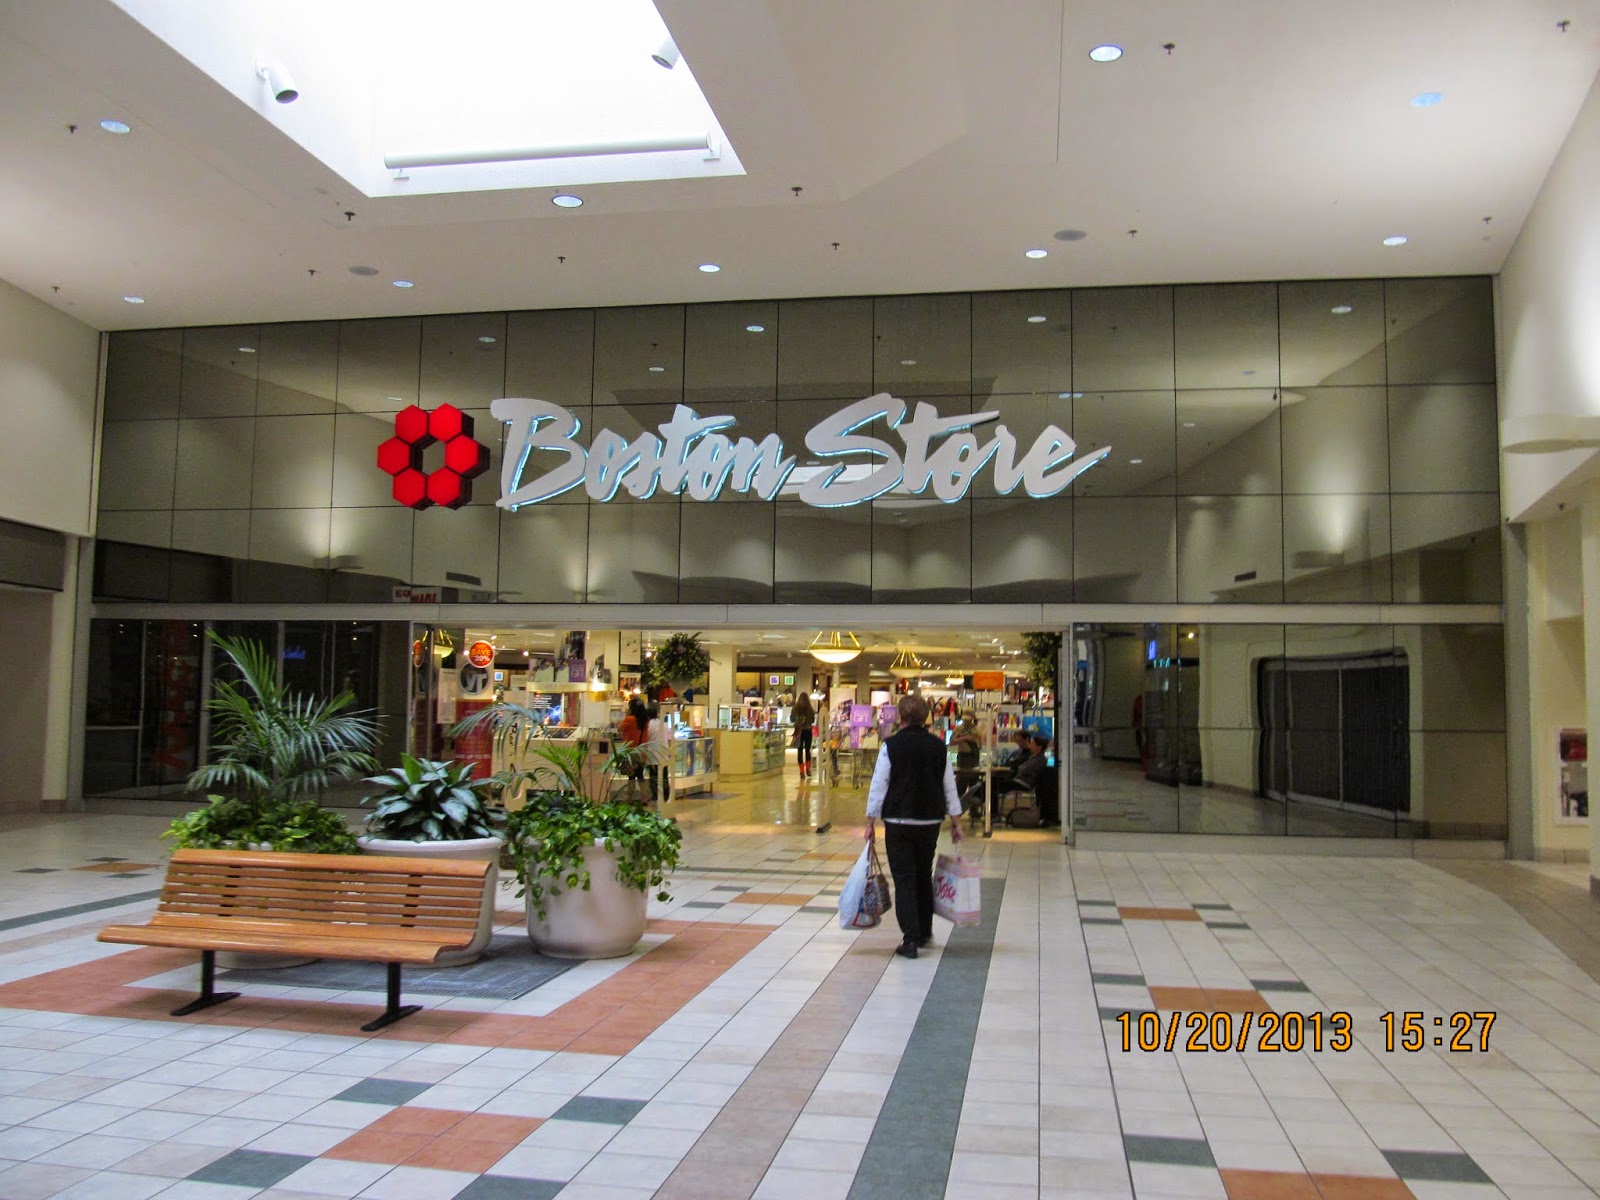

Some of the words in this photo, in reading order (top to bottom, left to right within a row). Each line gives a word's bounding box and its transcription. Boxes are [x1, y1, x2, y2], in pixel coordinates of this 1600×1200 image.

[490, 397, 799, 512] Boston
[800, 392, 1113, 508] Store
[471, 648, 491, 656] SAVE
